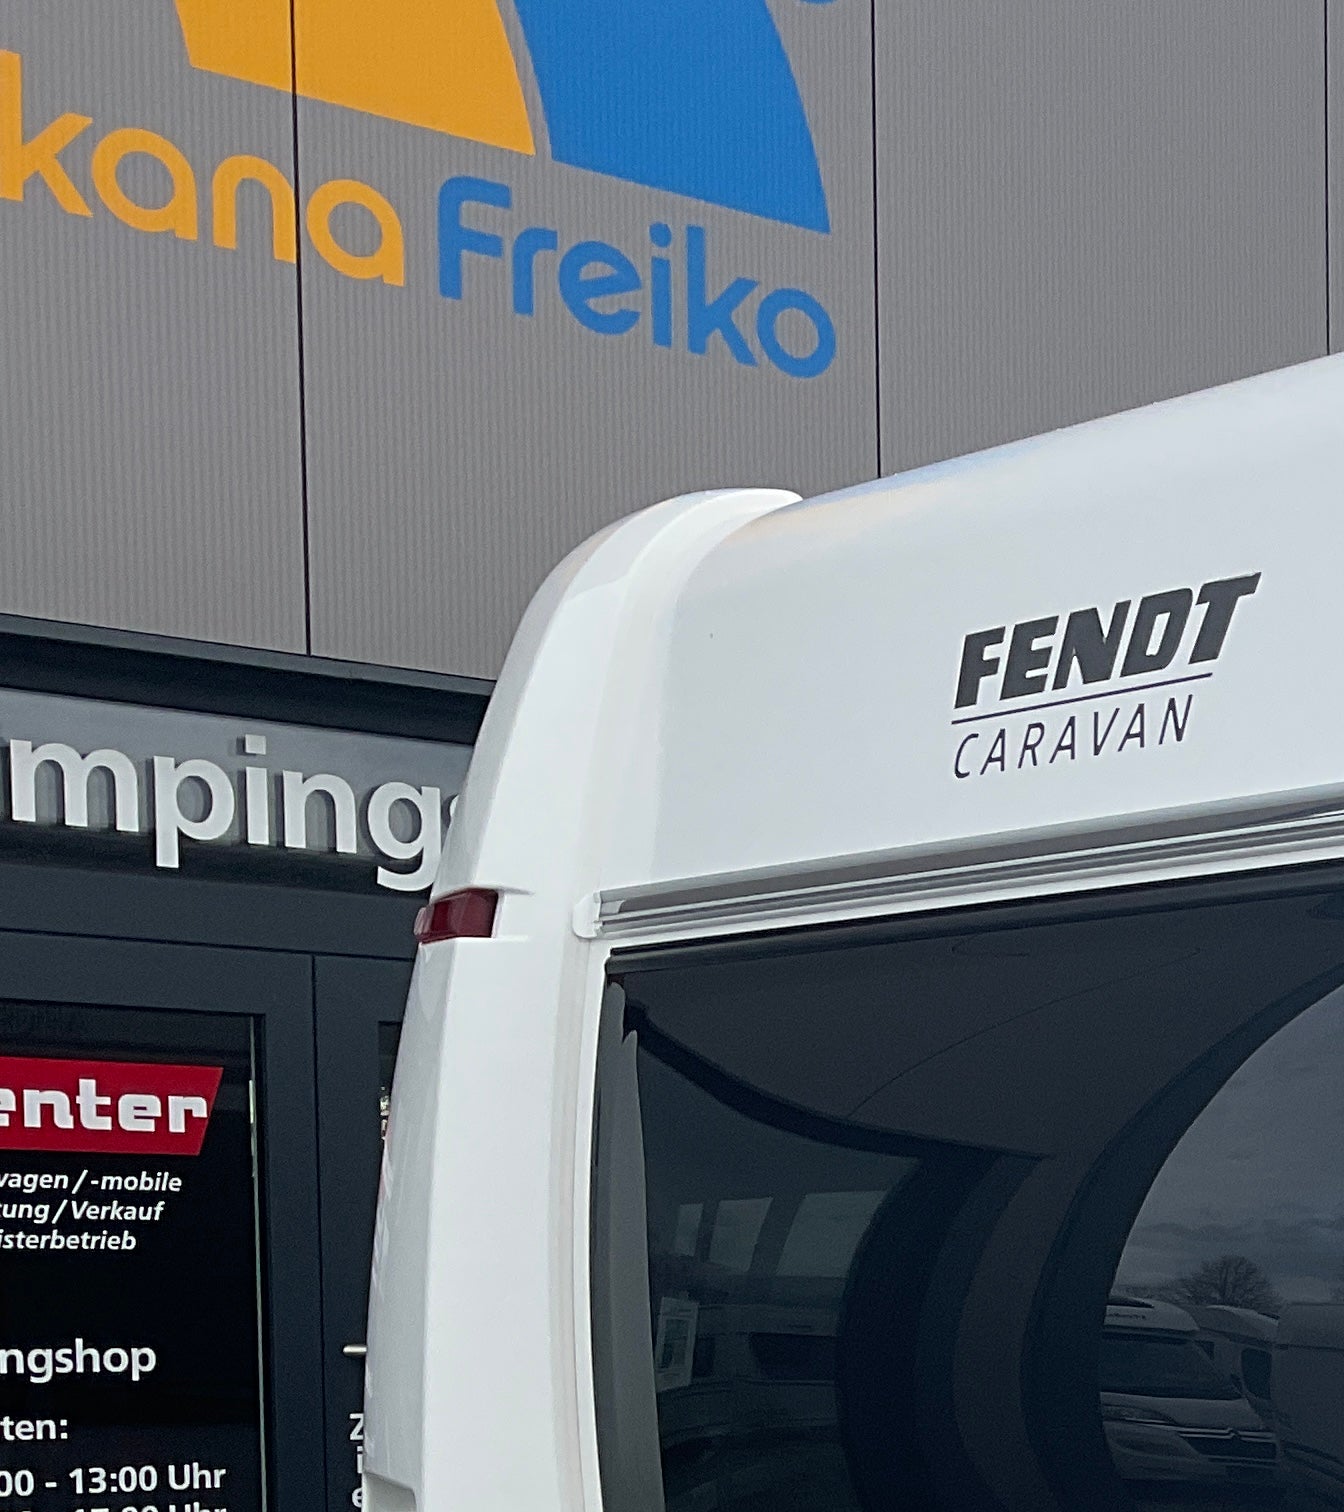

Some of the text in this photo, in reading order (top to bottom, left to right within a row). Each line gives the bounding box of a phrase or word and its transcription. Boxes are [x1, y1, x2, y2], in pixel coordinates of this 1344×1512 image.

[0, 49, 838, 379] kana Freiko
[954, 571, 1262, 710] FENDT
[953, 694, 1193, 779] CARAVAN
[9, 734, 460, 892] mping
[0, 1416, 69, 1441] ten:
[69, 1465, 158, 1494] 13:00
[168, 1462, 227, 1490] Uhr
